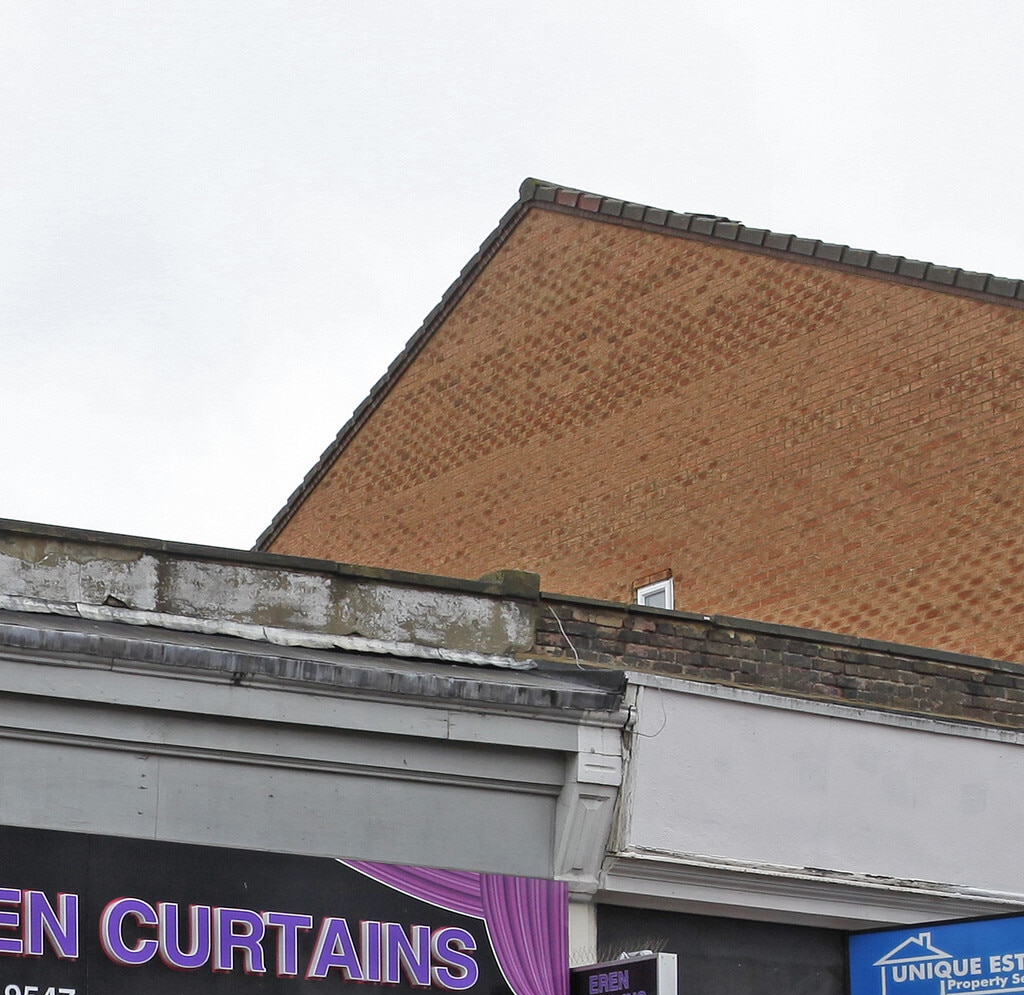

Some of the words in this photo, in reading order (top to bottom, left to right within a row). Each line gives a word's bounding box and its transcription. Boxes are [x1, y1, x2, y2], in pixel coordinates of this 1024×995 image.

[99, 896, 479, 992] CURTAINS
[892, 957, 982, 983] UNIQUE
[989, 953, 1024, 973] EST
[588, 970, 630, 995] EREN
[947, 976, 1009, 991] Property
